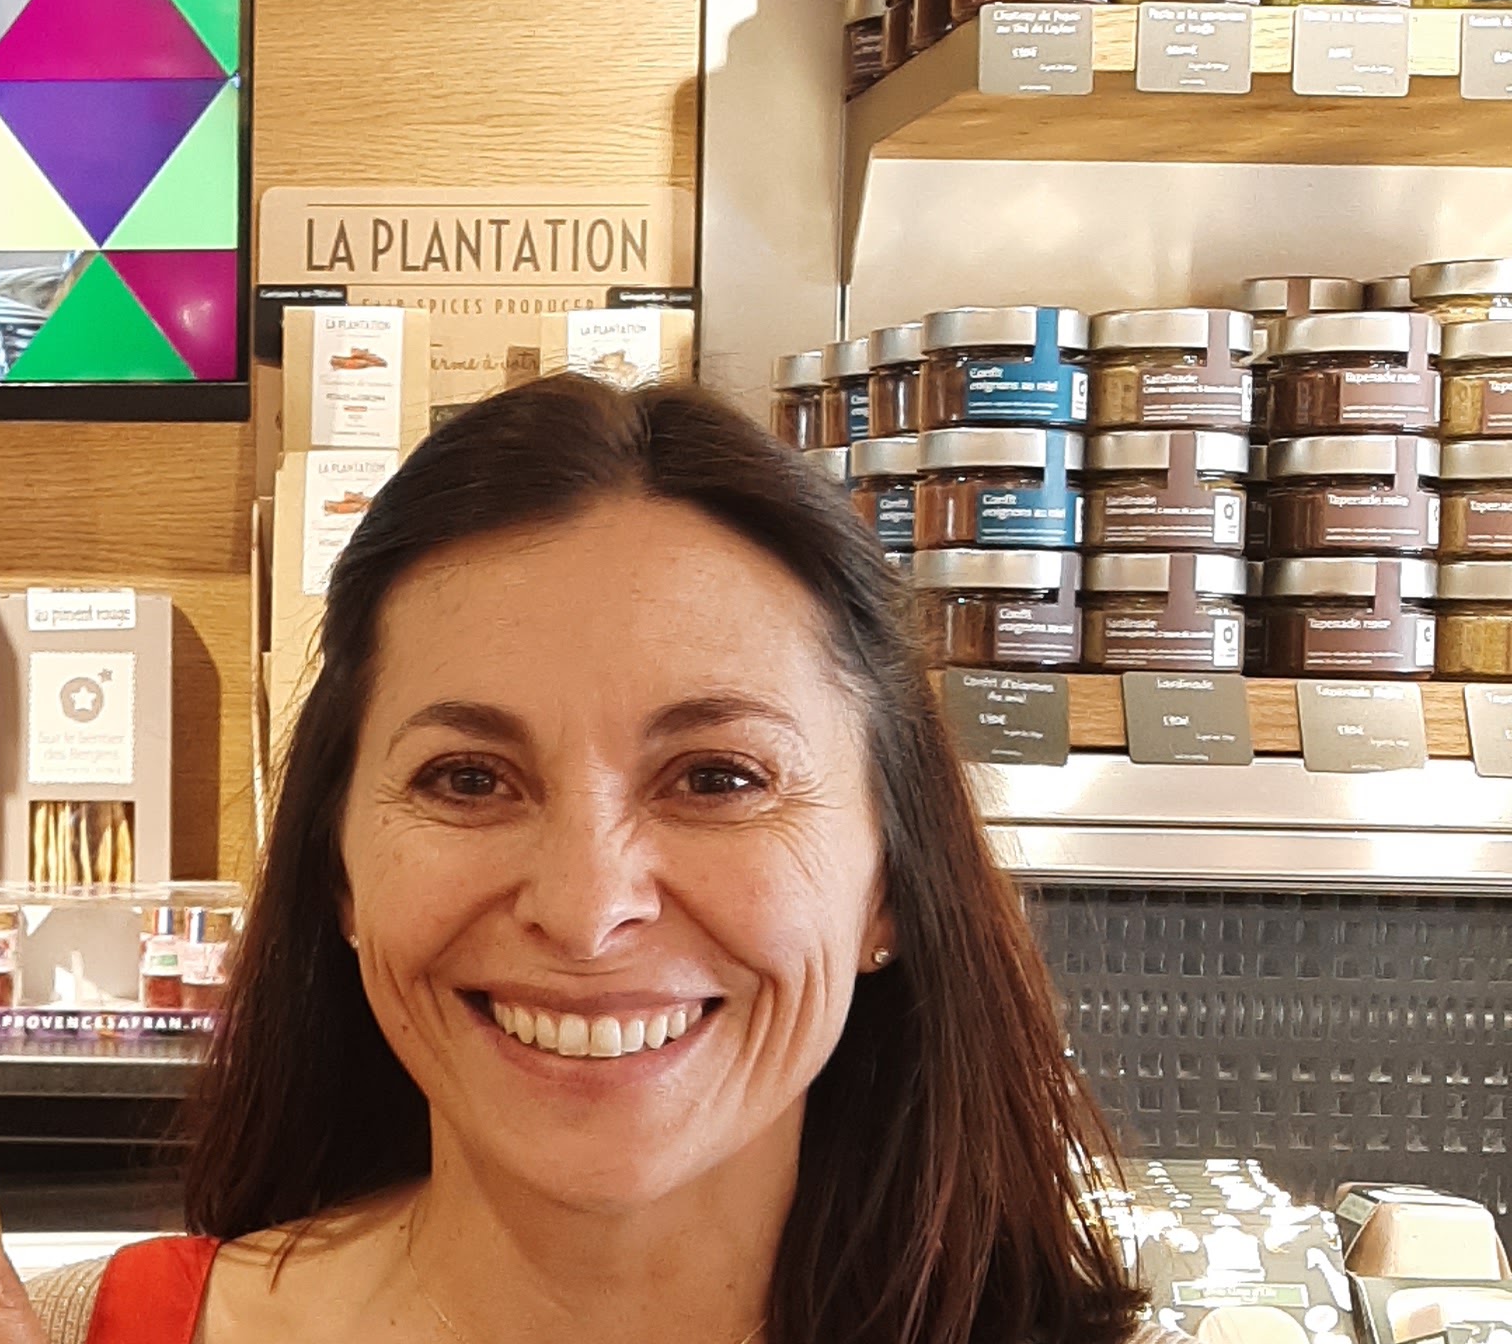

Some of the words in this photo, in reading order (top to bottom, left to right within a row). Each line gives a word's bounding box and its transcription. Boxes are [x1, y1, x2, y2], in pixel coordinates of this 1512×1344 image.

[306, 217, 356, 273] LA
[372, 217, 649, 273] PLANTATION
[417, 297, 483, 315] SPICES
